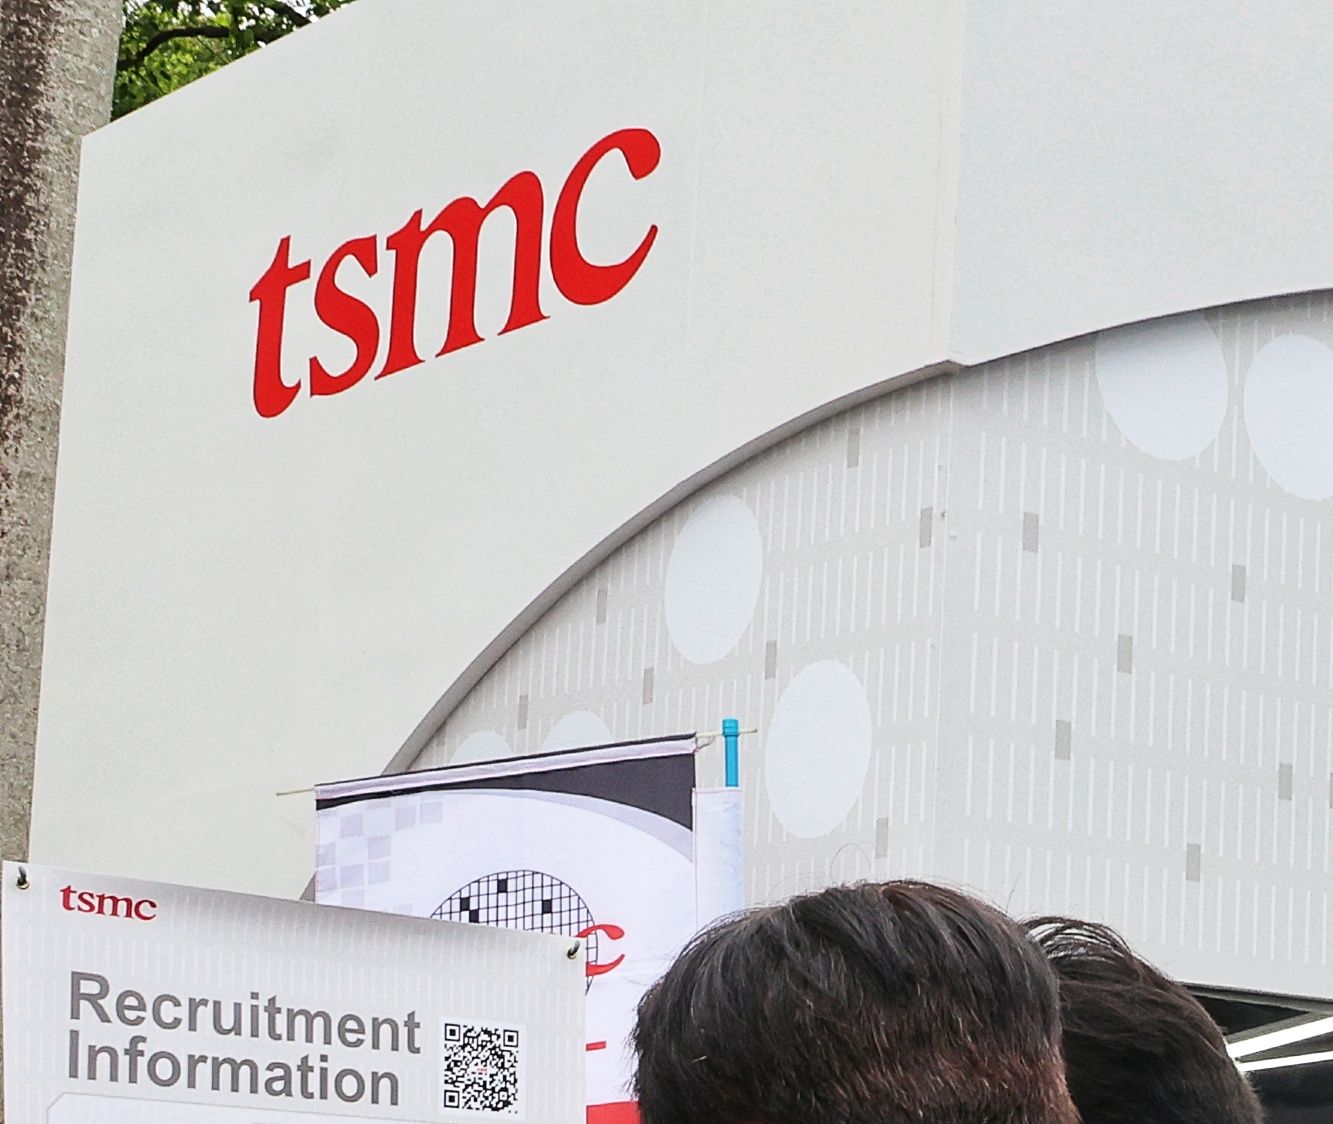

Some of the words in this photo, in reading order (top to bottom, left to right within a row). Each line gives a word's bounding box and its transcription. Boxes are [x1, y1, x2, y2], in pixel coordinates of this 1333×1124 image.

[249, 128, 661, 418] tsmc
[60, 884, 157, 921] tsmc
[70, 970, 421, 1055] Recruitment
[68, 1030, 400, 1106] Information
